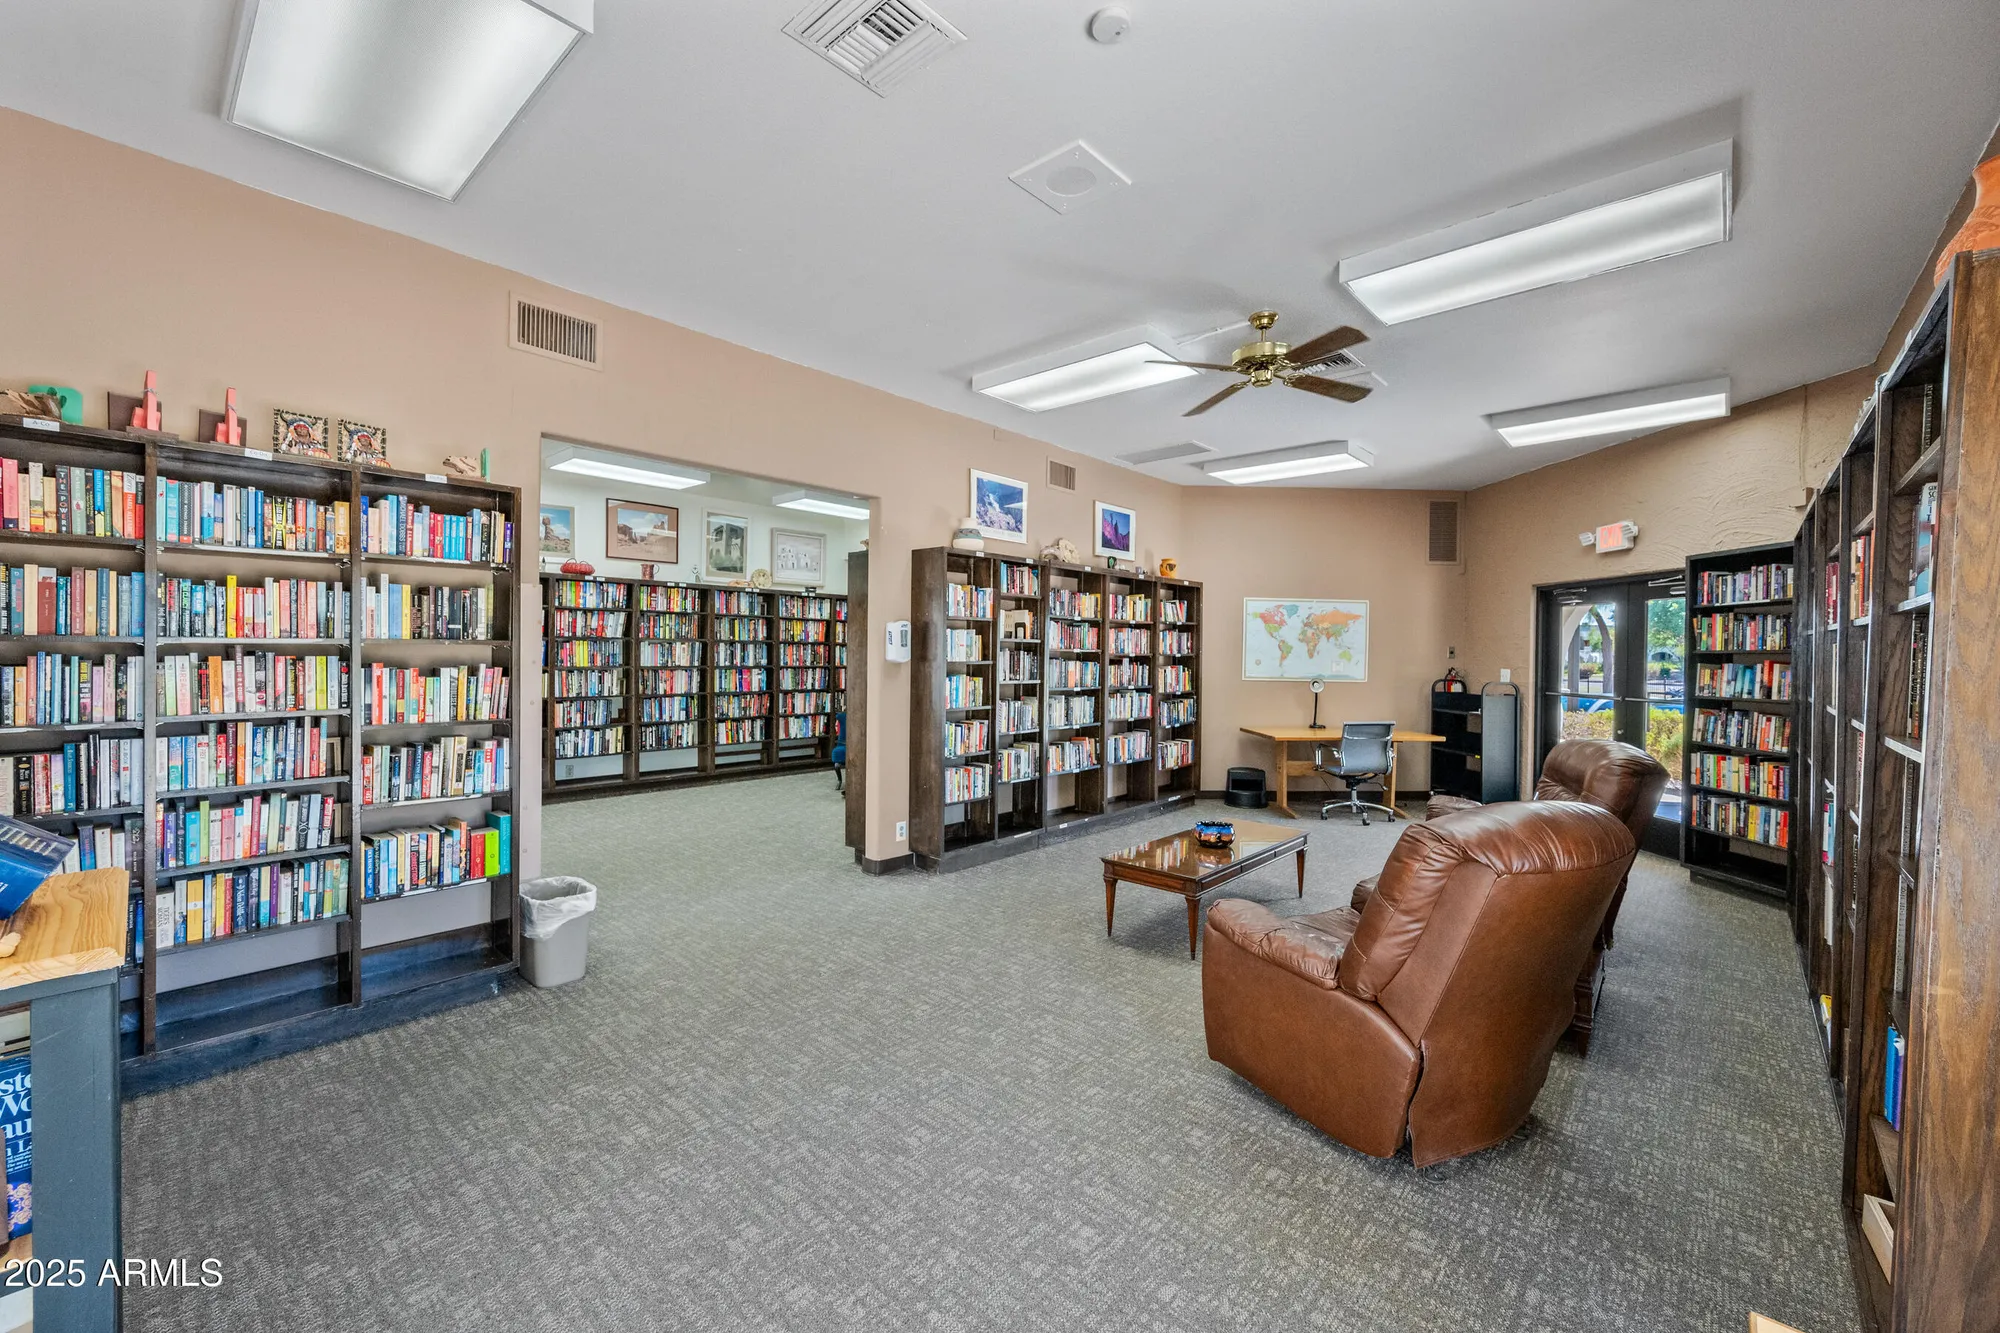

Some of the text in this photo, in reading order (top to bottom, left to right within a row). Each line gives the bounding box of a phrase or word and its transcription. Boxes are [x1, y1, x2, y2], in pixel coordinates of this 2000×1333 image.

[399, 501, 407, 522] MICHAEL
[1600, 524, 1623, 549] EXIT
[299, 822, 309, 834] XO
